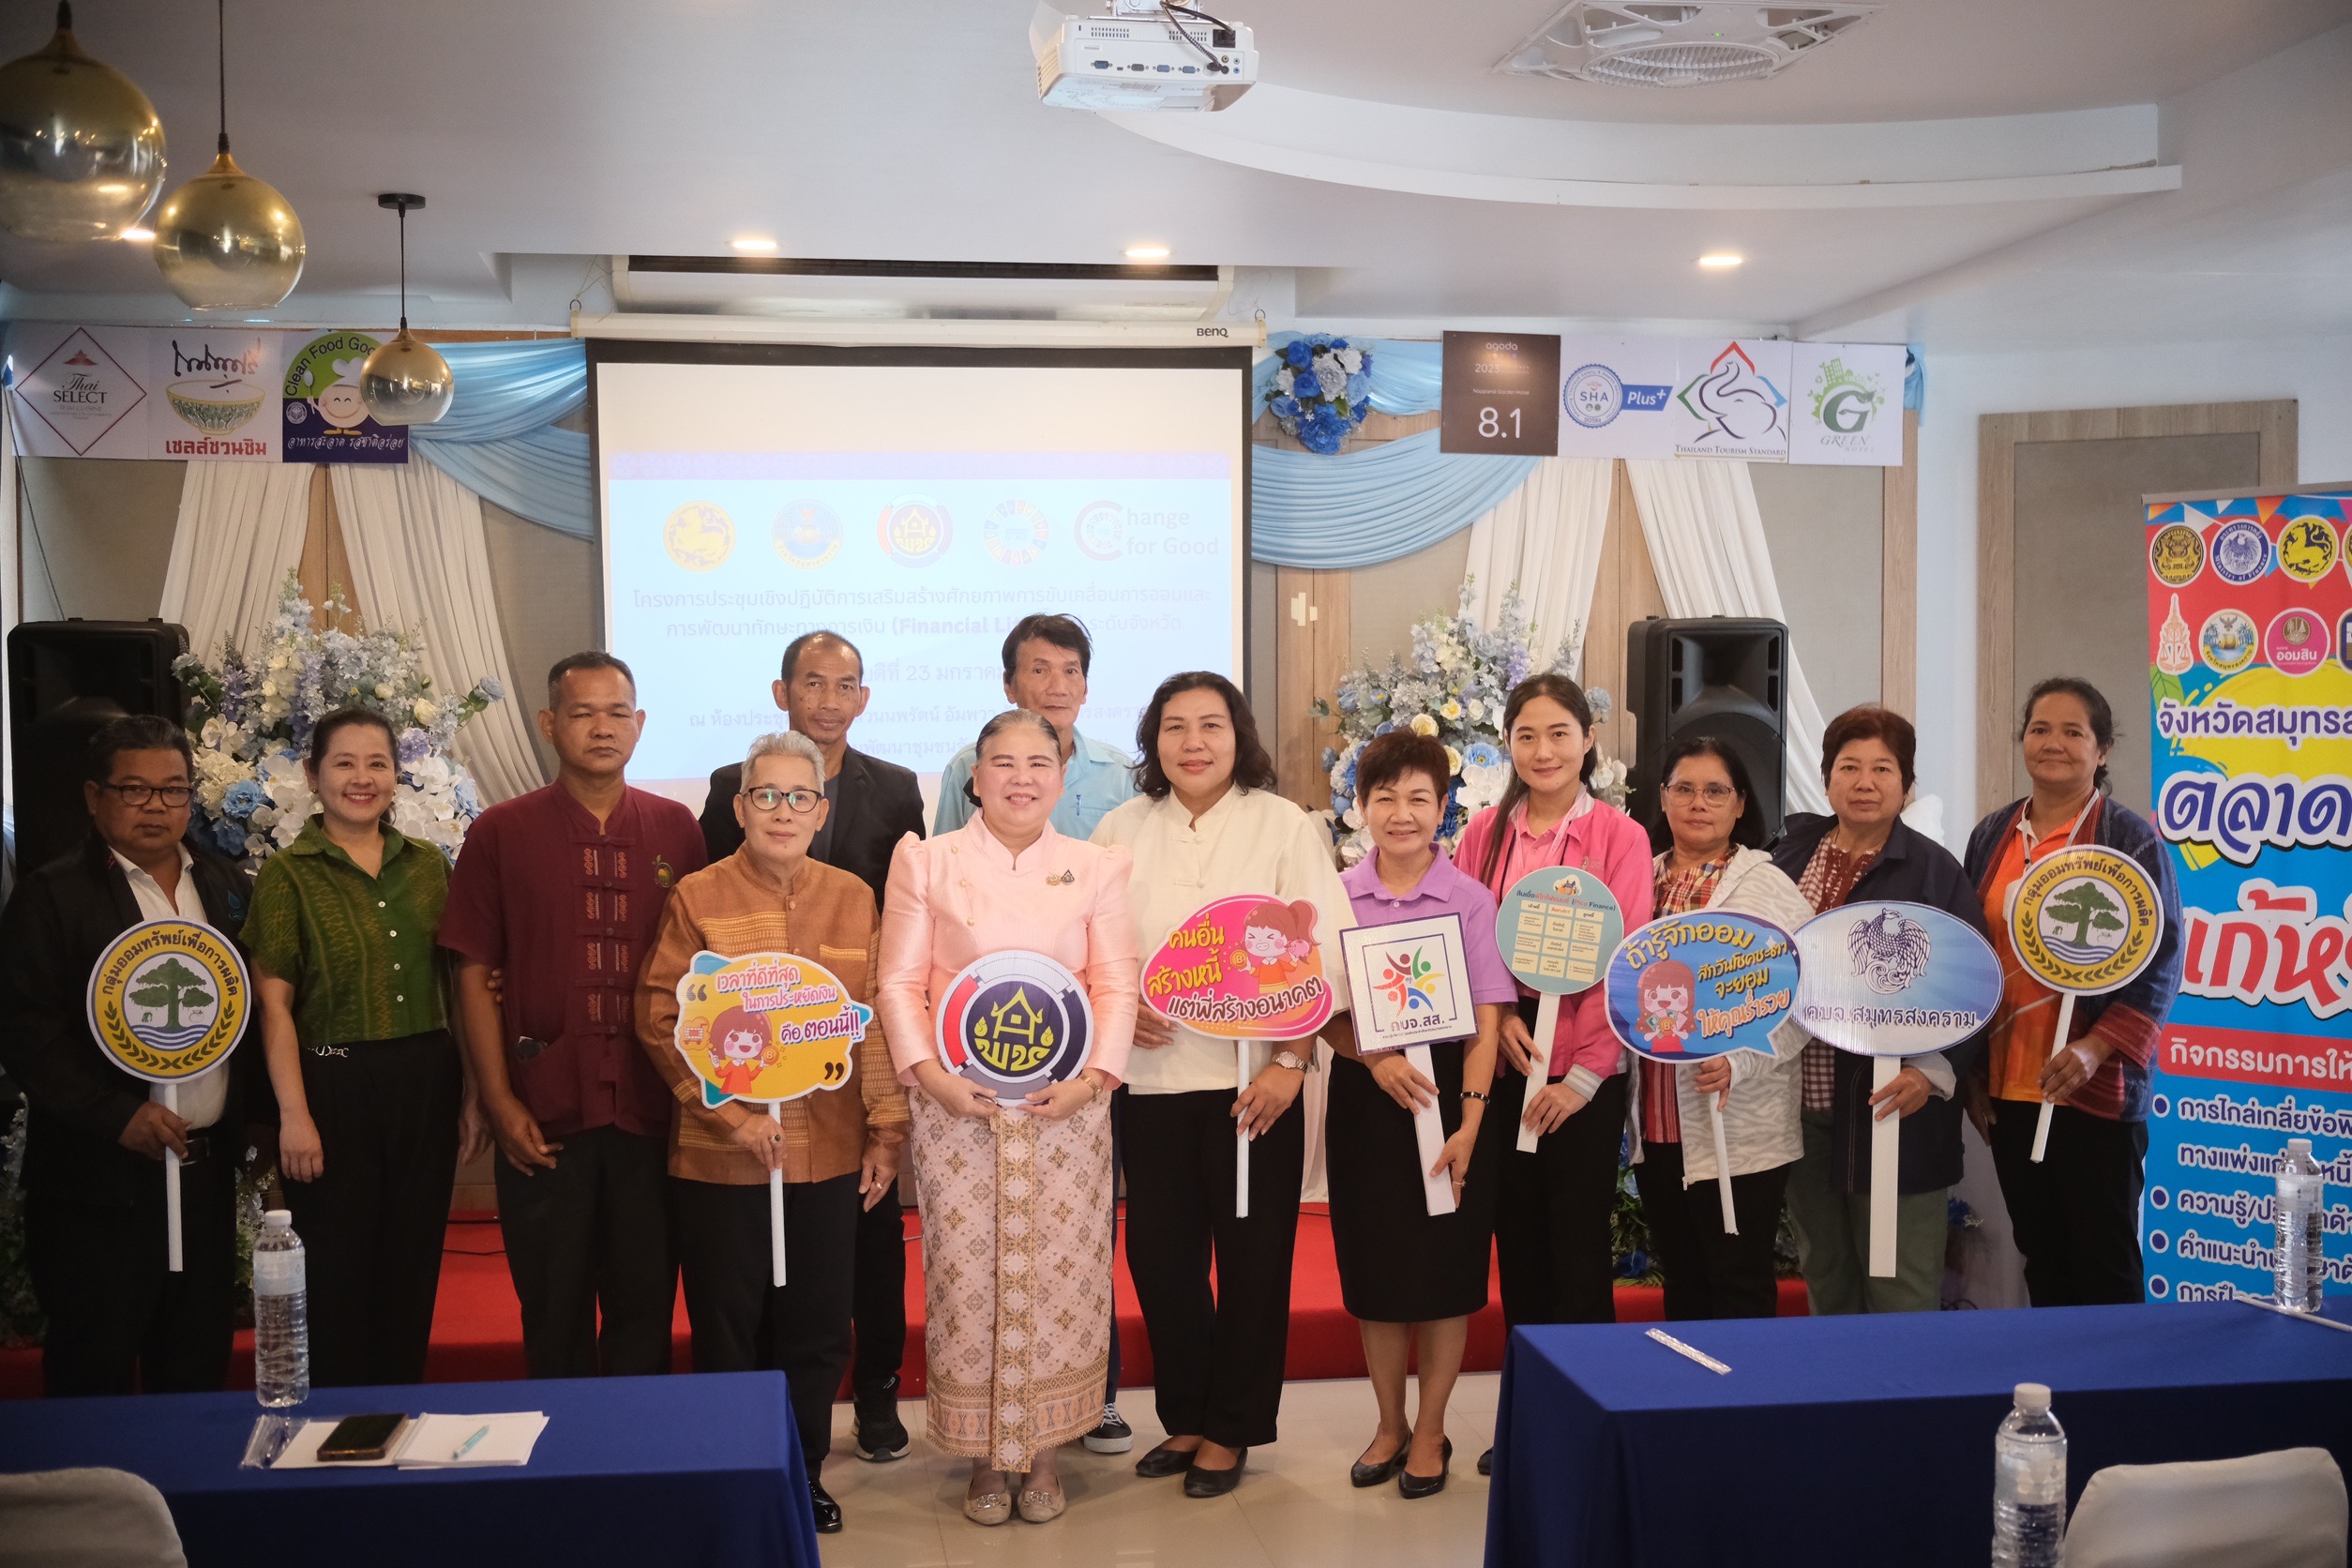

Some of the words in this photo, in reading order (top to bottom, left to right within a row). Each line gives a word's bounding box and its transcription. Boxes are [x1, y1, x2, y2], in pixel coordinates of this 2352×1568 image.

[1197, 327, 1229, 338] BenQ
[1485, 341, 1518, 352] agoda
[284, 357, 310, 397] Clean
[309, 337, 344, 359] Food
[348, 337, 375, 356] Goo
[1475, 363, 1500, 373] 2023
[62, 372, 99, 391] Thai
[53, 390, 108, 404] SELECT
[1579, 391, 1608, 402] SHA
[1478, 407, 1521, 439] 8.1
[166, 437, 267, 456] เชลล์ชวนชิม
[1675, 445, 1713, 453] THAILAND
[1749, 447, 1786, 456] STANDARD
[1820, 435, 1870, 448] GREEN
[1126, 536, 1156, 554] for
[1163, 537, 1219, 555] Good
[2276, 648, 2317, 661] ออมสิน
[906, 665, 930, 681] 23
[689, 714, 706, 728] ณ
[2023, 856, 2153, 927] กลุ่มออมทรัพย์เพื่อการผลิต
[1168, 912, 1225, 949] คนอื่น
[1625, 920, 1755, 971] ถ้ารู้จักออม
[102, 929, 240, 997] กลุ่มออมทรัพย์เพื่อการผลิต
[1147, 948, 1224, 998] สร้างหนี้
[716, 958, 800, 990] เวลาที่ดีที่สุด
[1715, 967, 1770, 999] จะยอม
[743, 986, 838, 1010] ในการประหยัดเงิน
[1168, 976, 1323, 1020] แต่พี่สร้างอนาคต
[1696, 988, 1790, 1038] ให้คุณร่ำรวย
[780, 1022, 802, 1043] คือ
